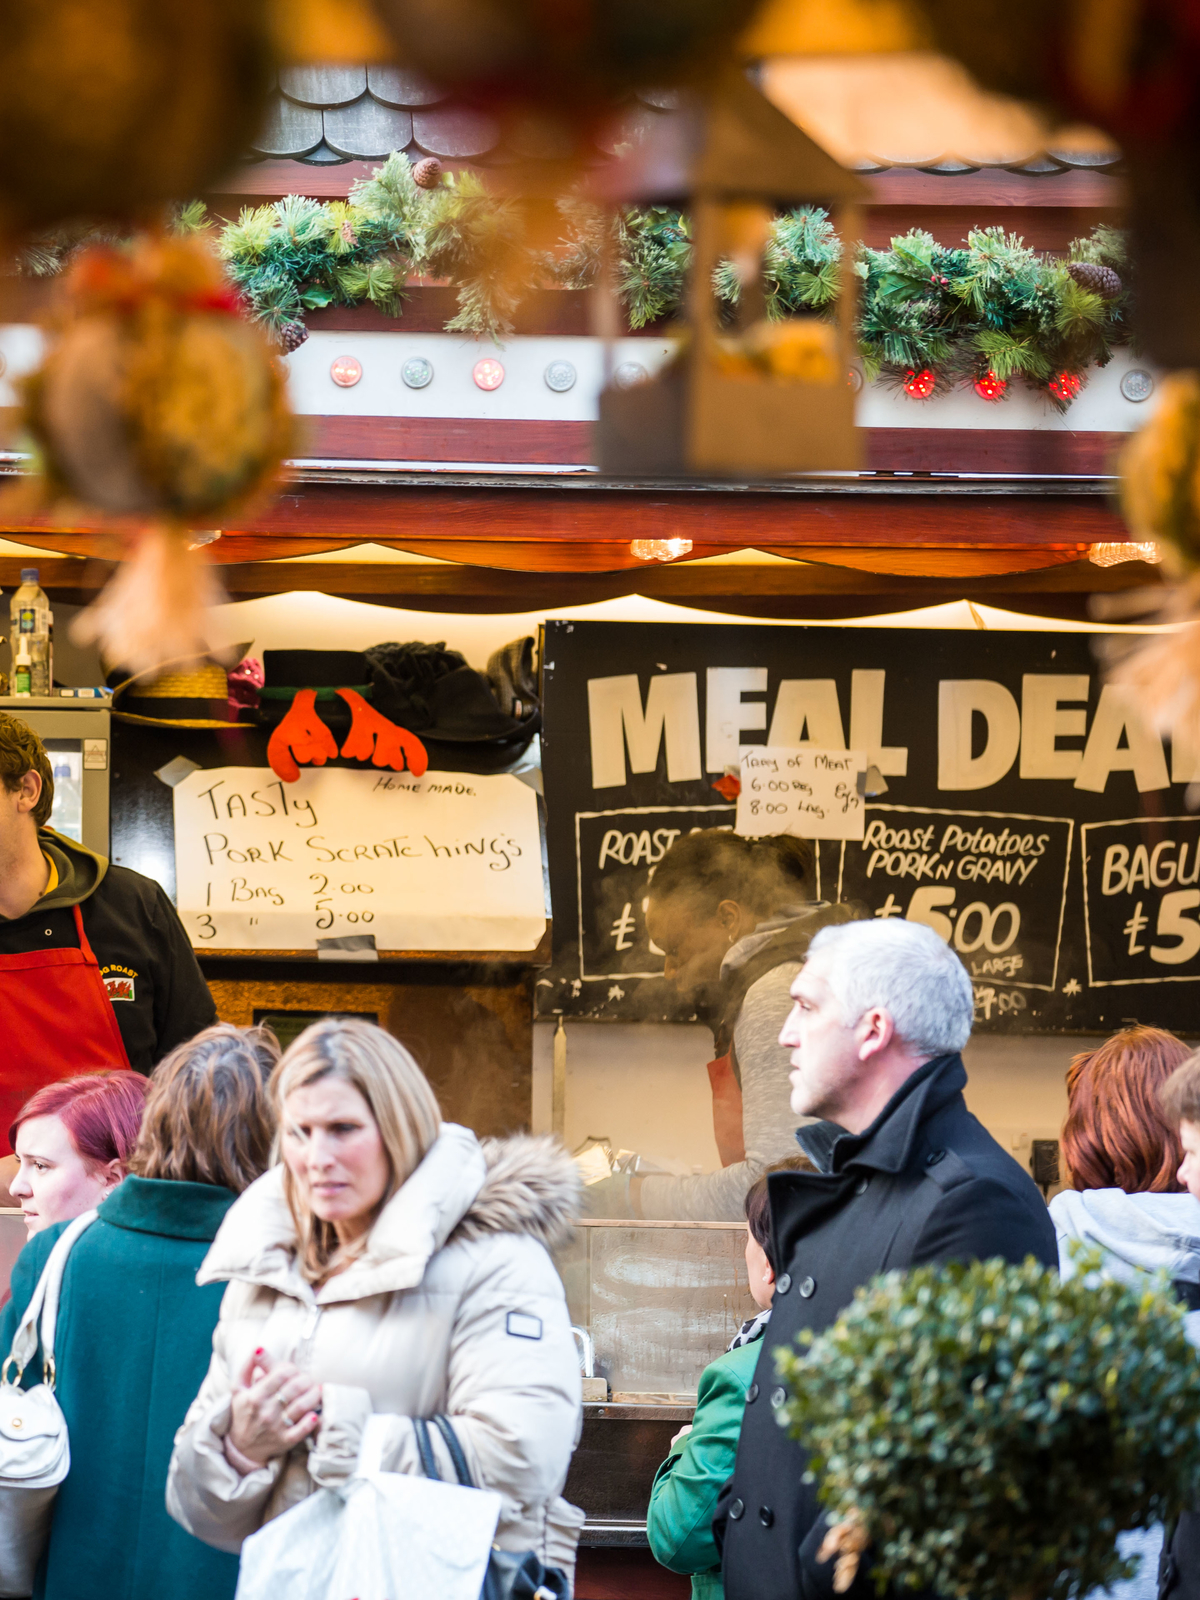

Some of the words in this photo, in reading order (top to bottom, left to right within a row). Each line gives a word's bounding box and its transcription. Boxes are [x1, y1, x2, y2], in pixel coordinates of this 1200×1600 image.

[586, 666, 908, 789] MEAL
[751, 778, 789, 792] 6.00
[750, 800, 788, 816] 8.00
[203, 832, 293, 865] PORK
[599, 828, 681, 870] ROAST
[862, 820, 935, 850] Roast
[940, 824, 1049, 856] Potatoes
[309, 873, 374, 896] 2.00
[866, 850, 941, 881] PORK
[956, 855, 1038, 886] GRAVY
[1102, 840, 1200, 895] BAGU
[196, 914, 217, 939] 3
[315, 898, 375, 930] 5.00
[110, 964, 139, 979] ROAST
